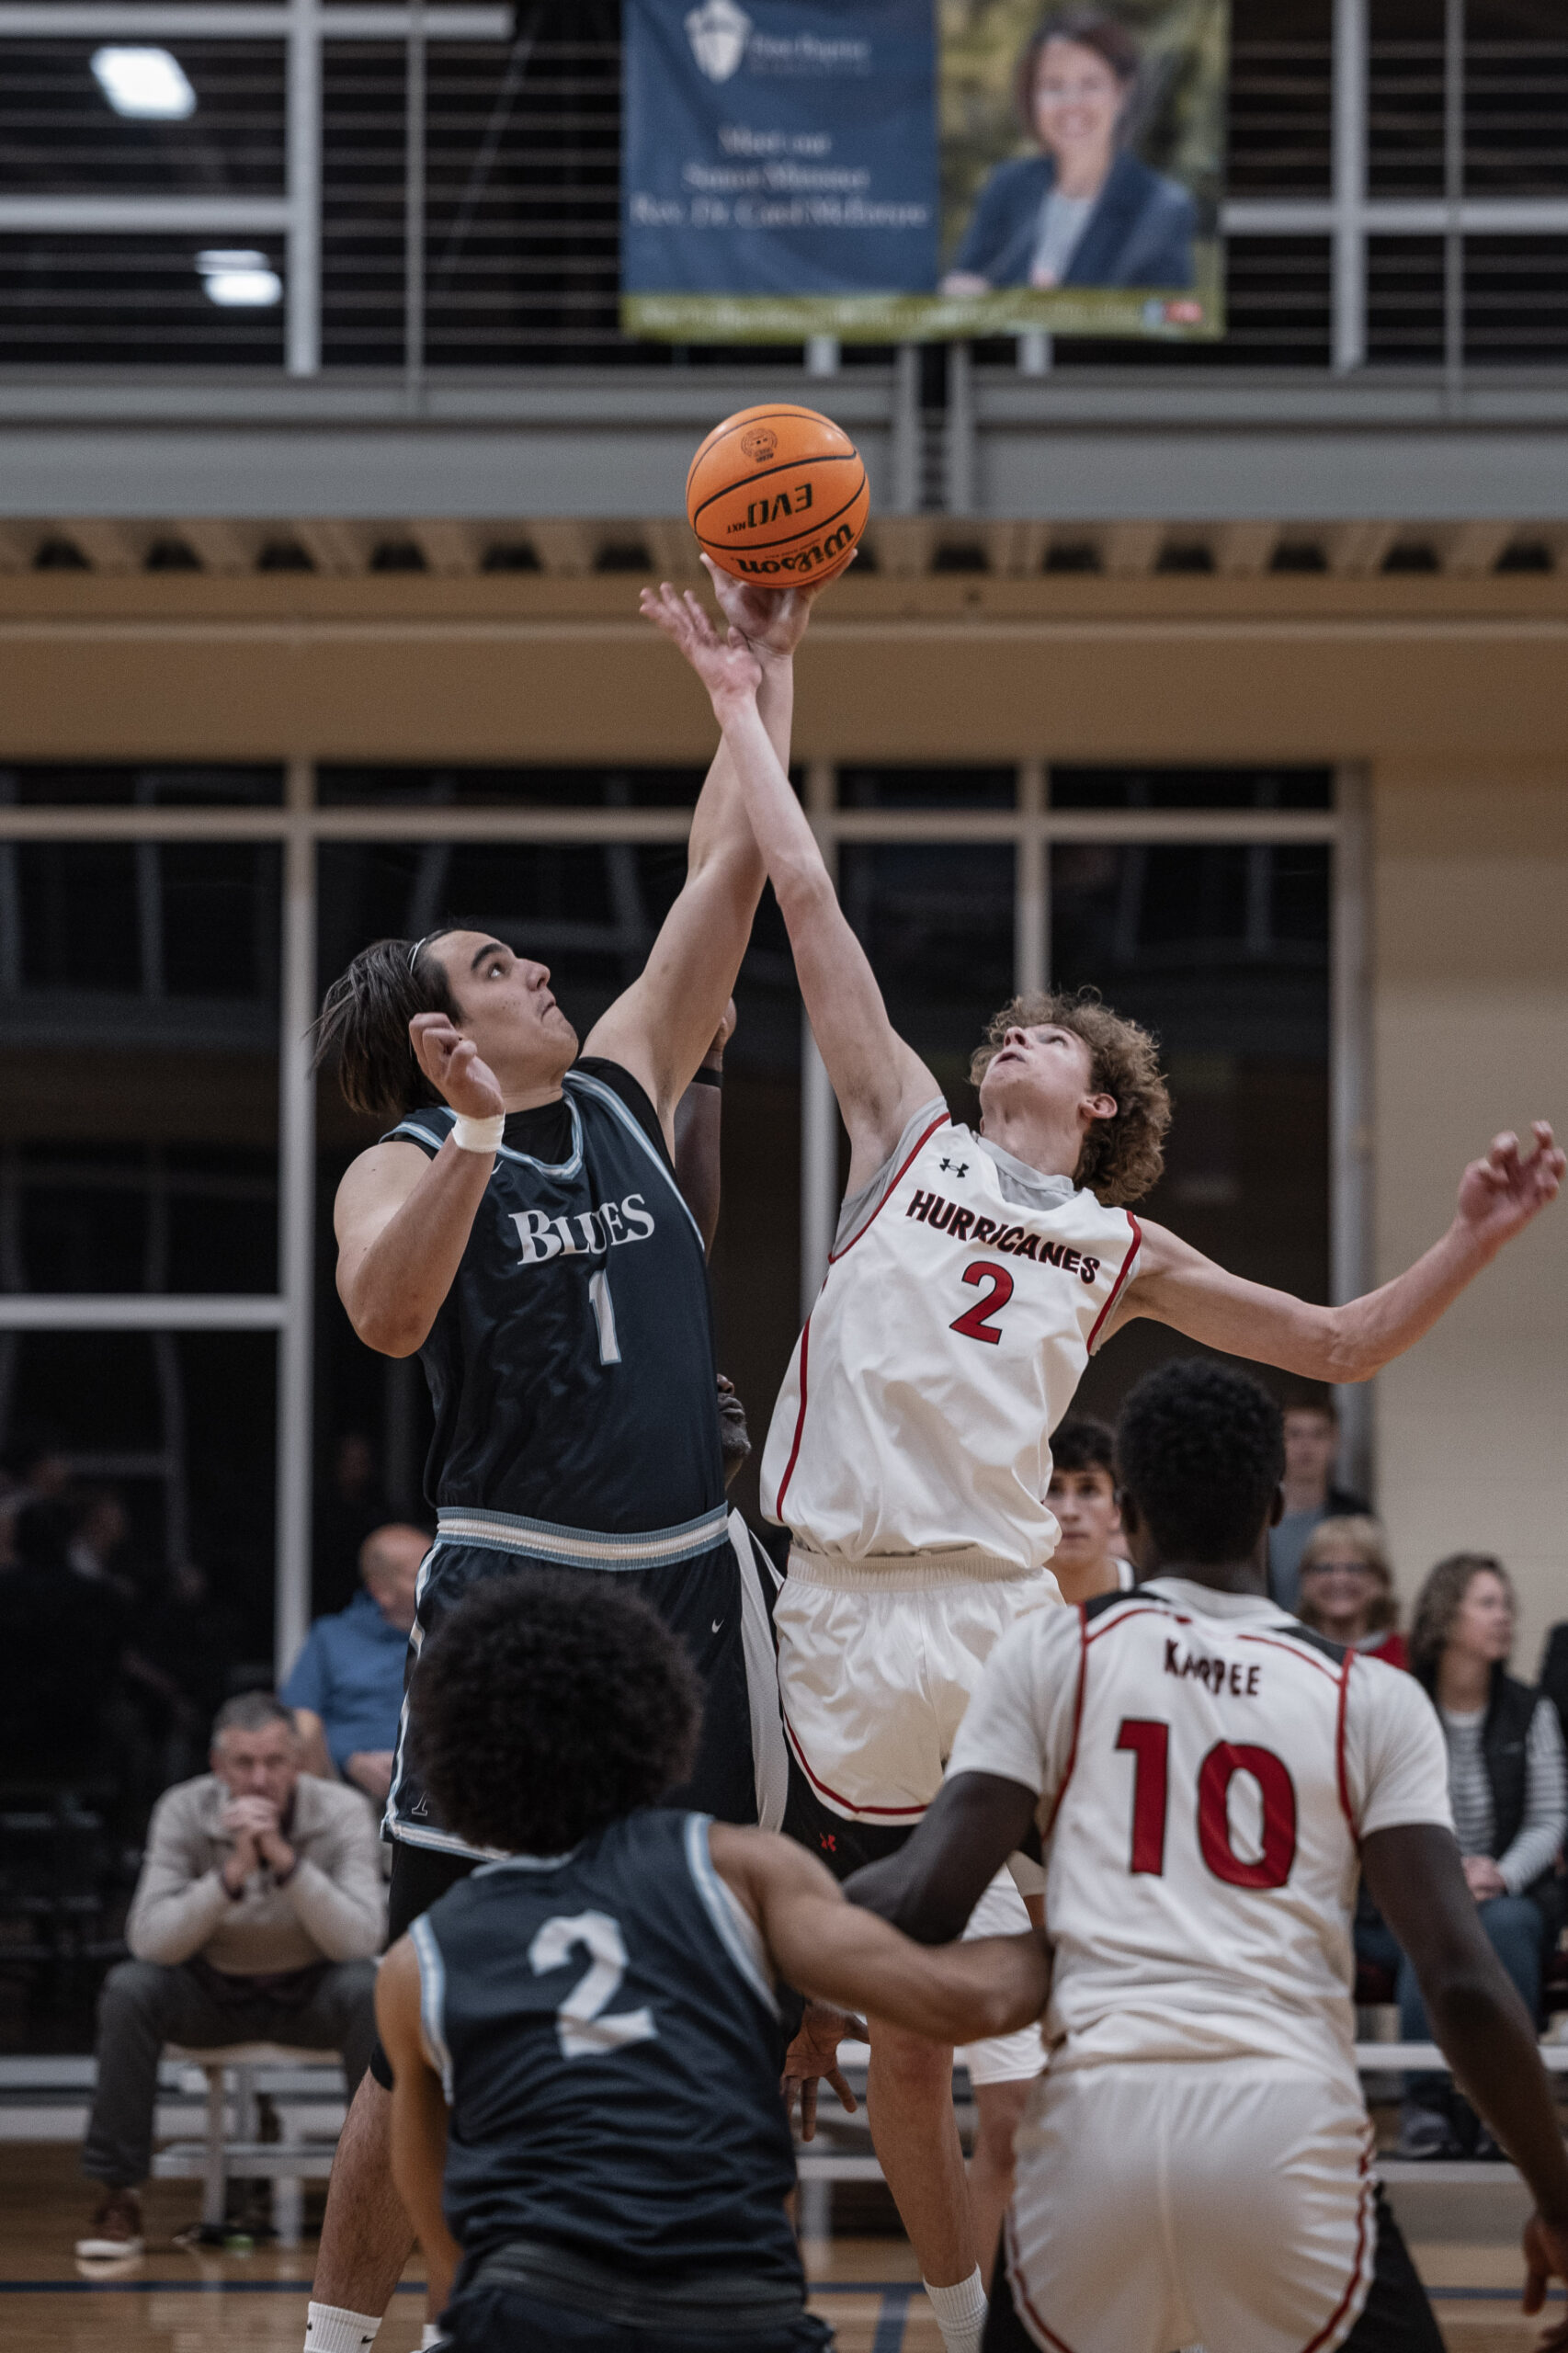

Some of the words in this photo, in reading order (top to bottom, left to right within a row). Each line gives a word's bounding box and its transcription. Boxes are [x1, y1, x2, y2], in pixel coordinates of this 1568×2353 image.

[726, 521, 746, 534] NXT
[736, 523, 855, 574] Wilson
[747, 483, 812, 529] EVO
[904, 1188, 1101, 1285] HURRICANES
[588, 1267, 622, 1366] 1
[949, 1260, 1015, 1346] 2
[1114, 1715, 1298, 1892] 10
[527, 1908, 660, 2062] 2
